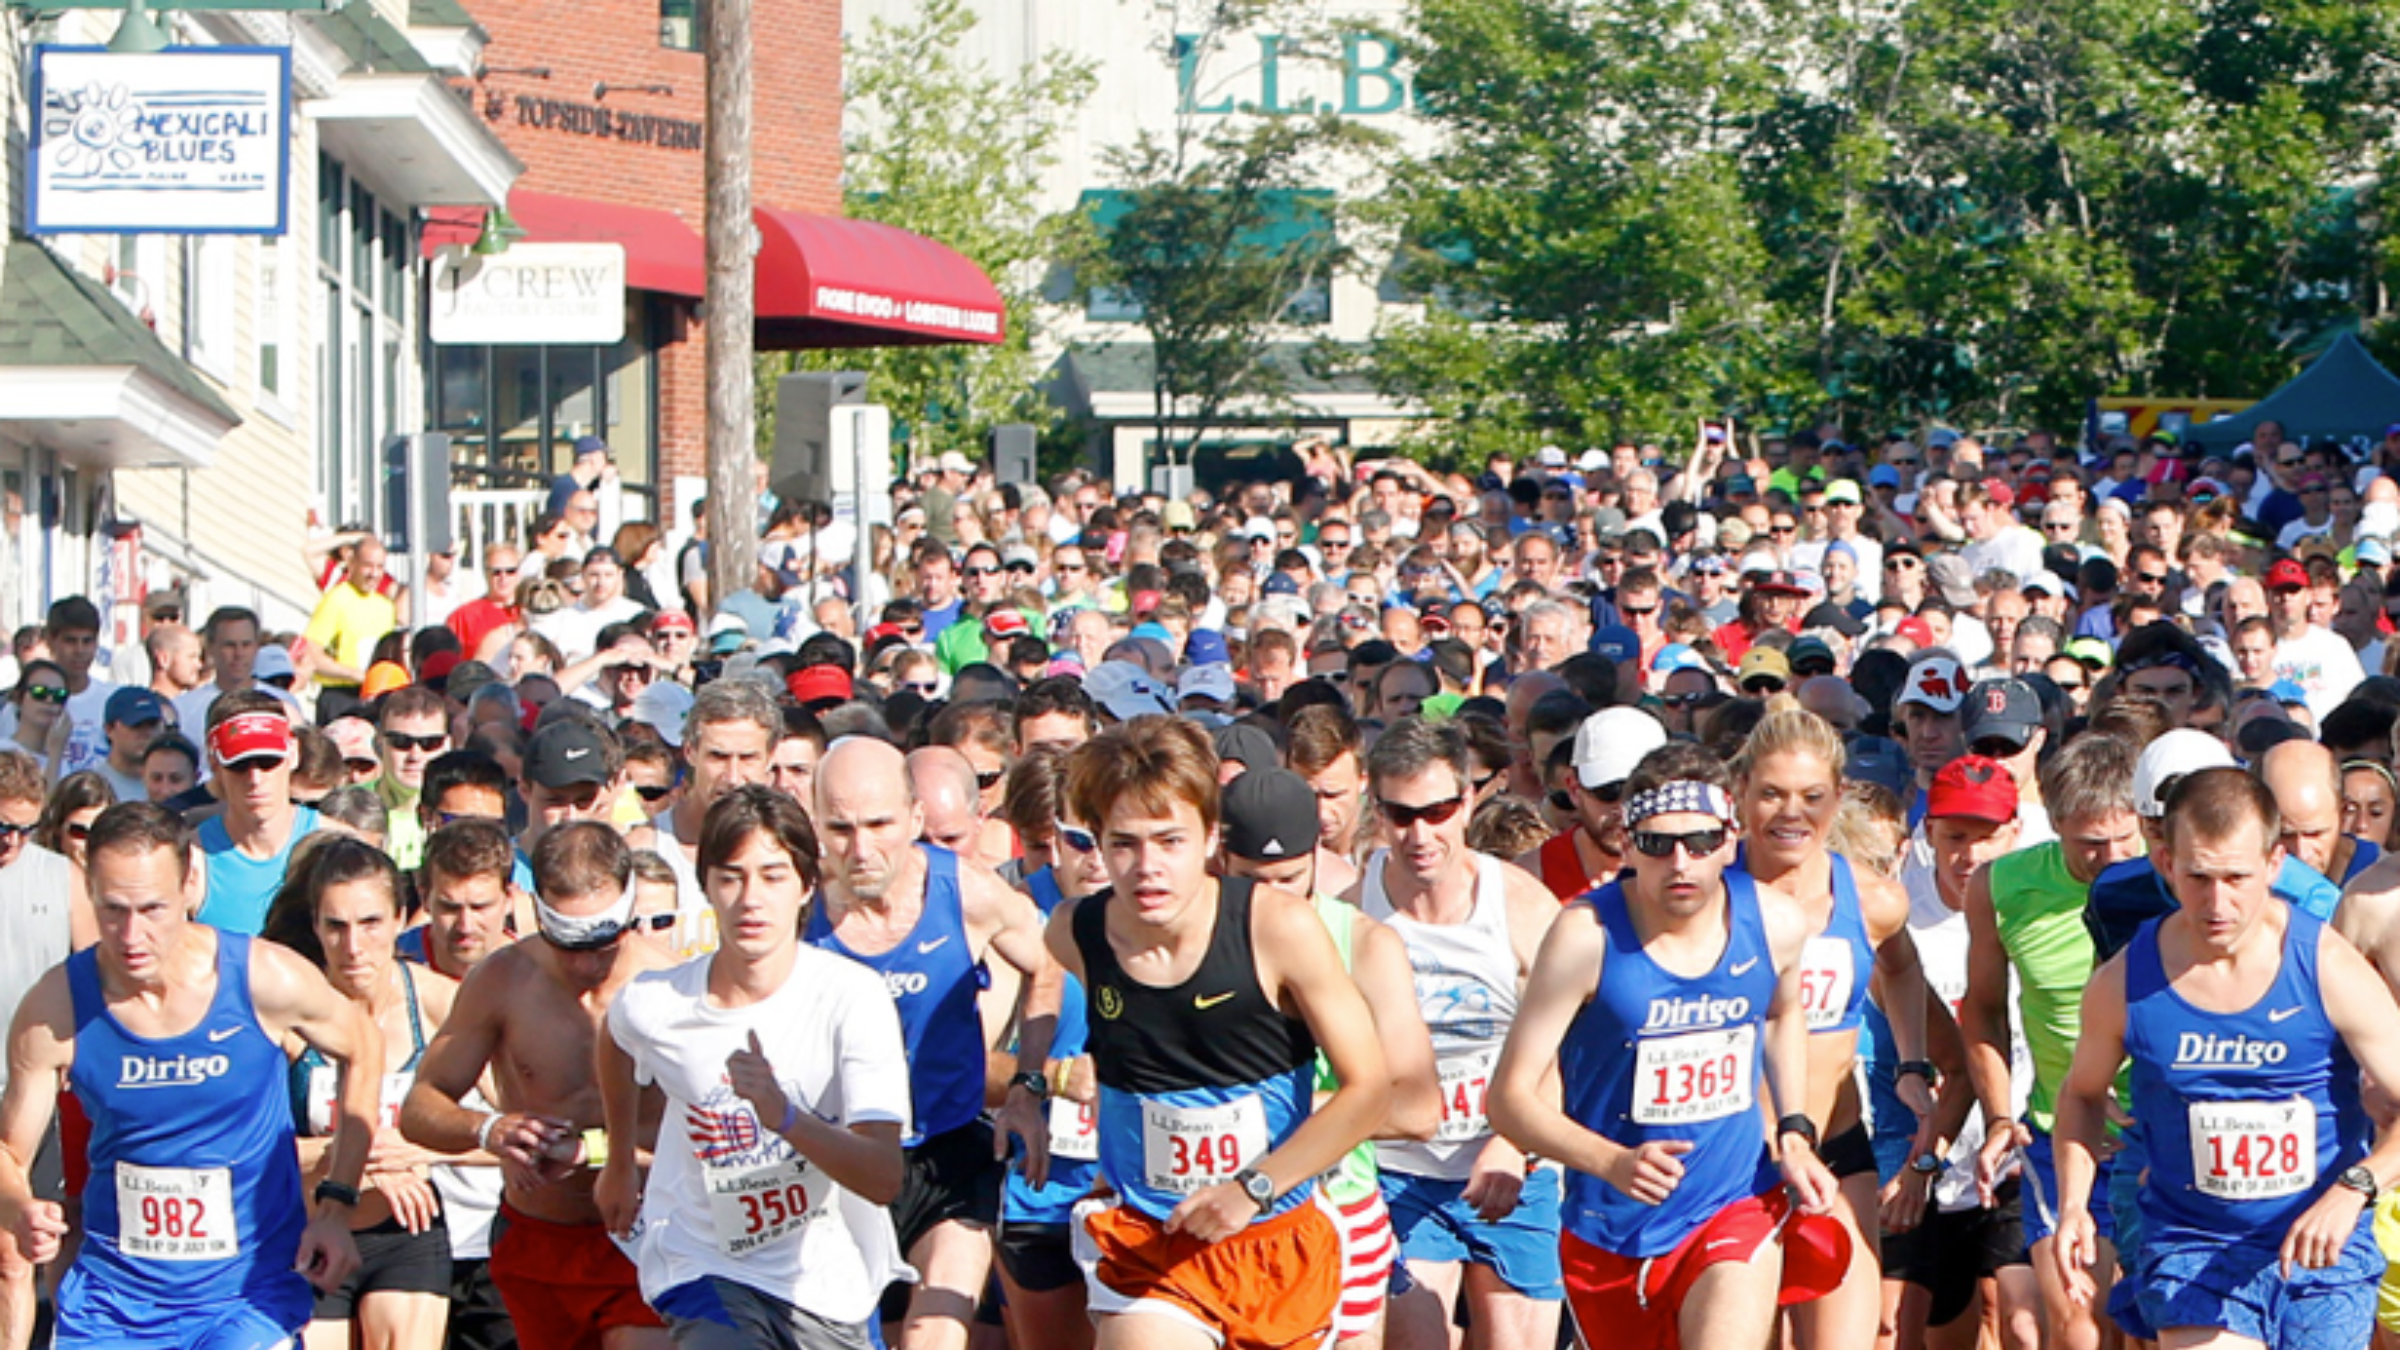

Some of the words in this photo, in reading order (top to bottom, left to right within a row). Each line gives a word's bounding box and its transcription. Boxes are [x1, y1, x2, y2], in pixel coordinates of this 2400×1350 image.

[134, 112, 269, 137] MEXICALI
[515, 95, 611, 139] TOPSIDE
[613, 111, 702, 150] TAVERN
[143, 139, 236, 163] BLUES
[463, 302, 542, 316] FACTORY
[547, 302, 602, 316] STORE
[905, 300, 961, 329] LOBSTER
[1985, 690, 2007, 714] B
[1637, 993, 1751, 1035] Dirigo
[117, 1053, 230, 1088] Dirigo
[2171, 1031, 2289, 1071] Dirigo
[1651, 1053, 1738, 1106] 1369
[1168, 1133, 1240, 1176] 349
[2207, 1133, 2299, 1178] 1428
[142, 1195, 209, 1239] 982
[738, 1183, 808, 1235] 350
